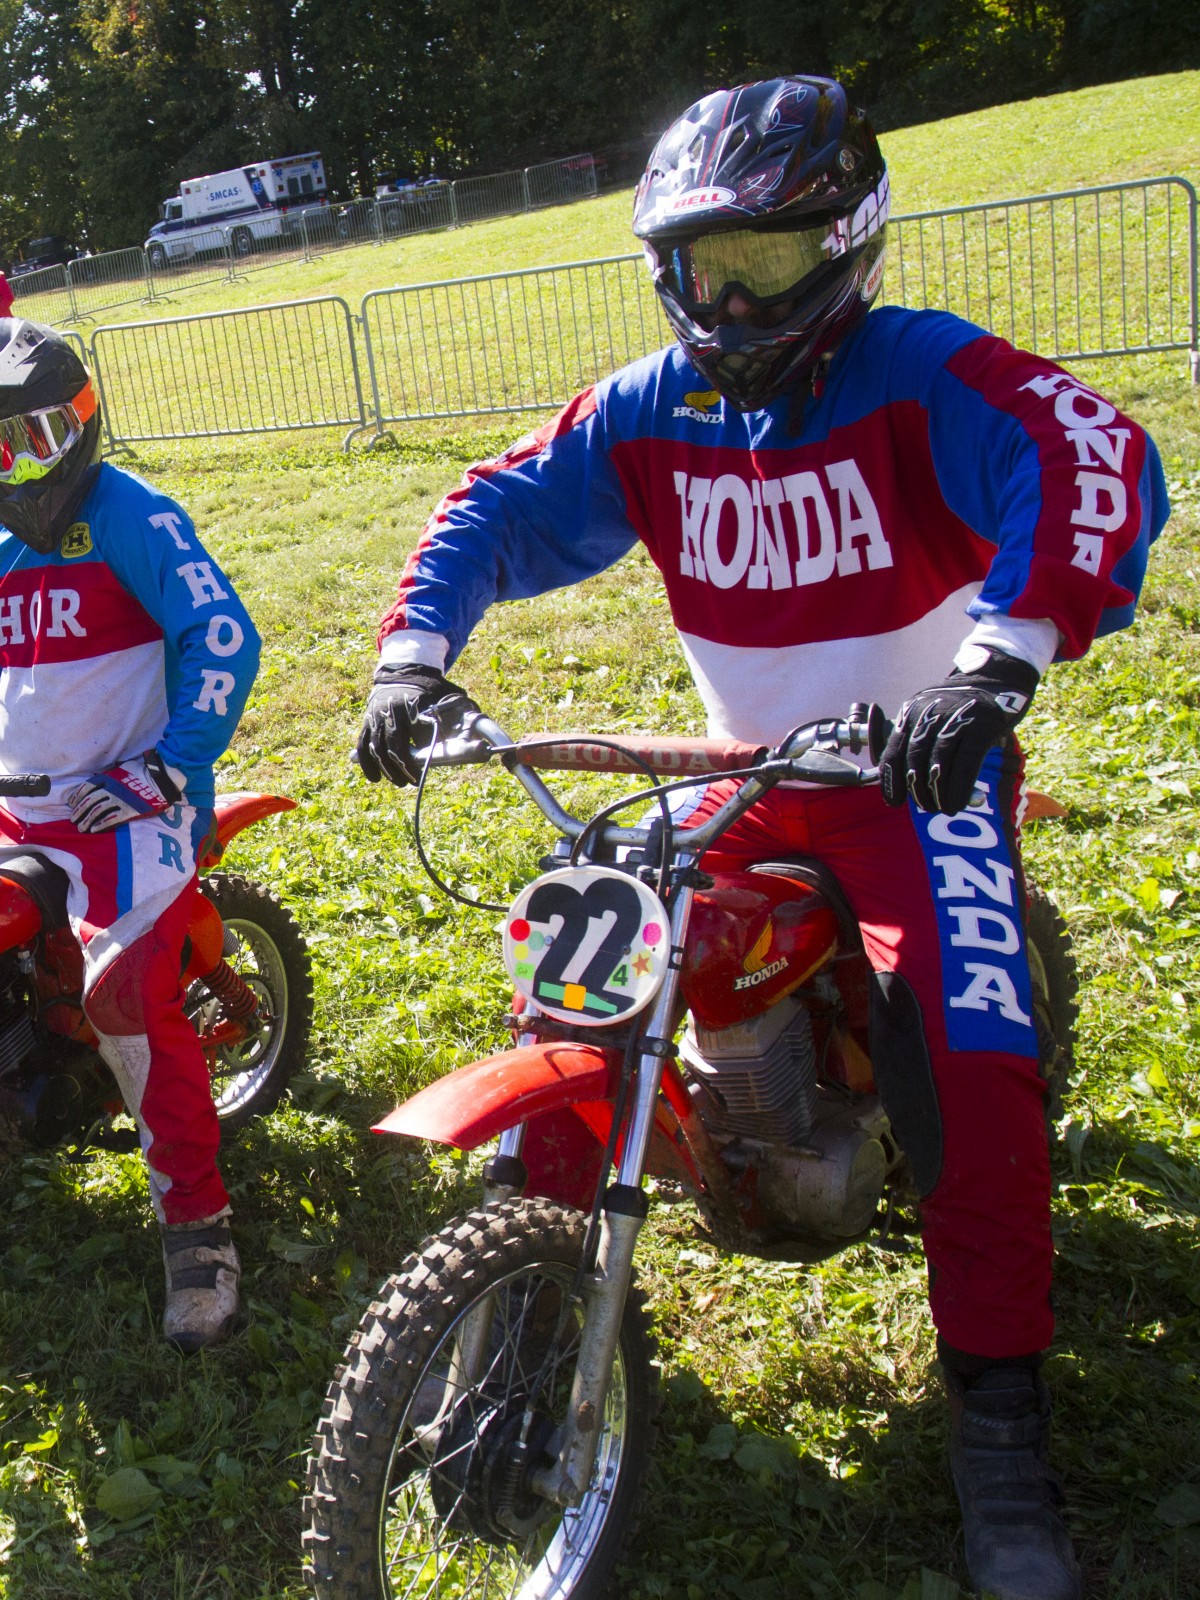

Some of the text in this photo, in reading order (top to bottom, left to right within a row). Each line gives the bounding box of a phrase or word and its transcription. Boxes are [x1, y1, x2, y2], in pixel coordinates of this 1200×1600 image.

[210, 187, 239, 201] SMCAS
[674, 193, 721, 209] BELL
[672, 406, 724, 424] HOND
[1016, 373, 1131, 577] HONDA
[673, 458, 894, 591] HONDA
[148, 512, 244, 716] THOR
[550, 744, 718, 771] HONDA
[525, 877, 643, 1019] 22
[612, 963, 629, 987] 4
[734, 956, 789, 991] HONDA
